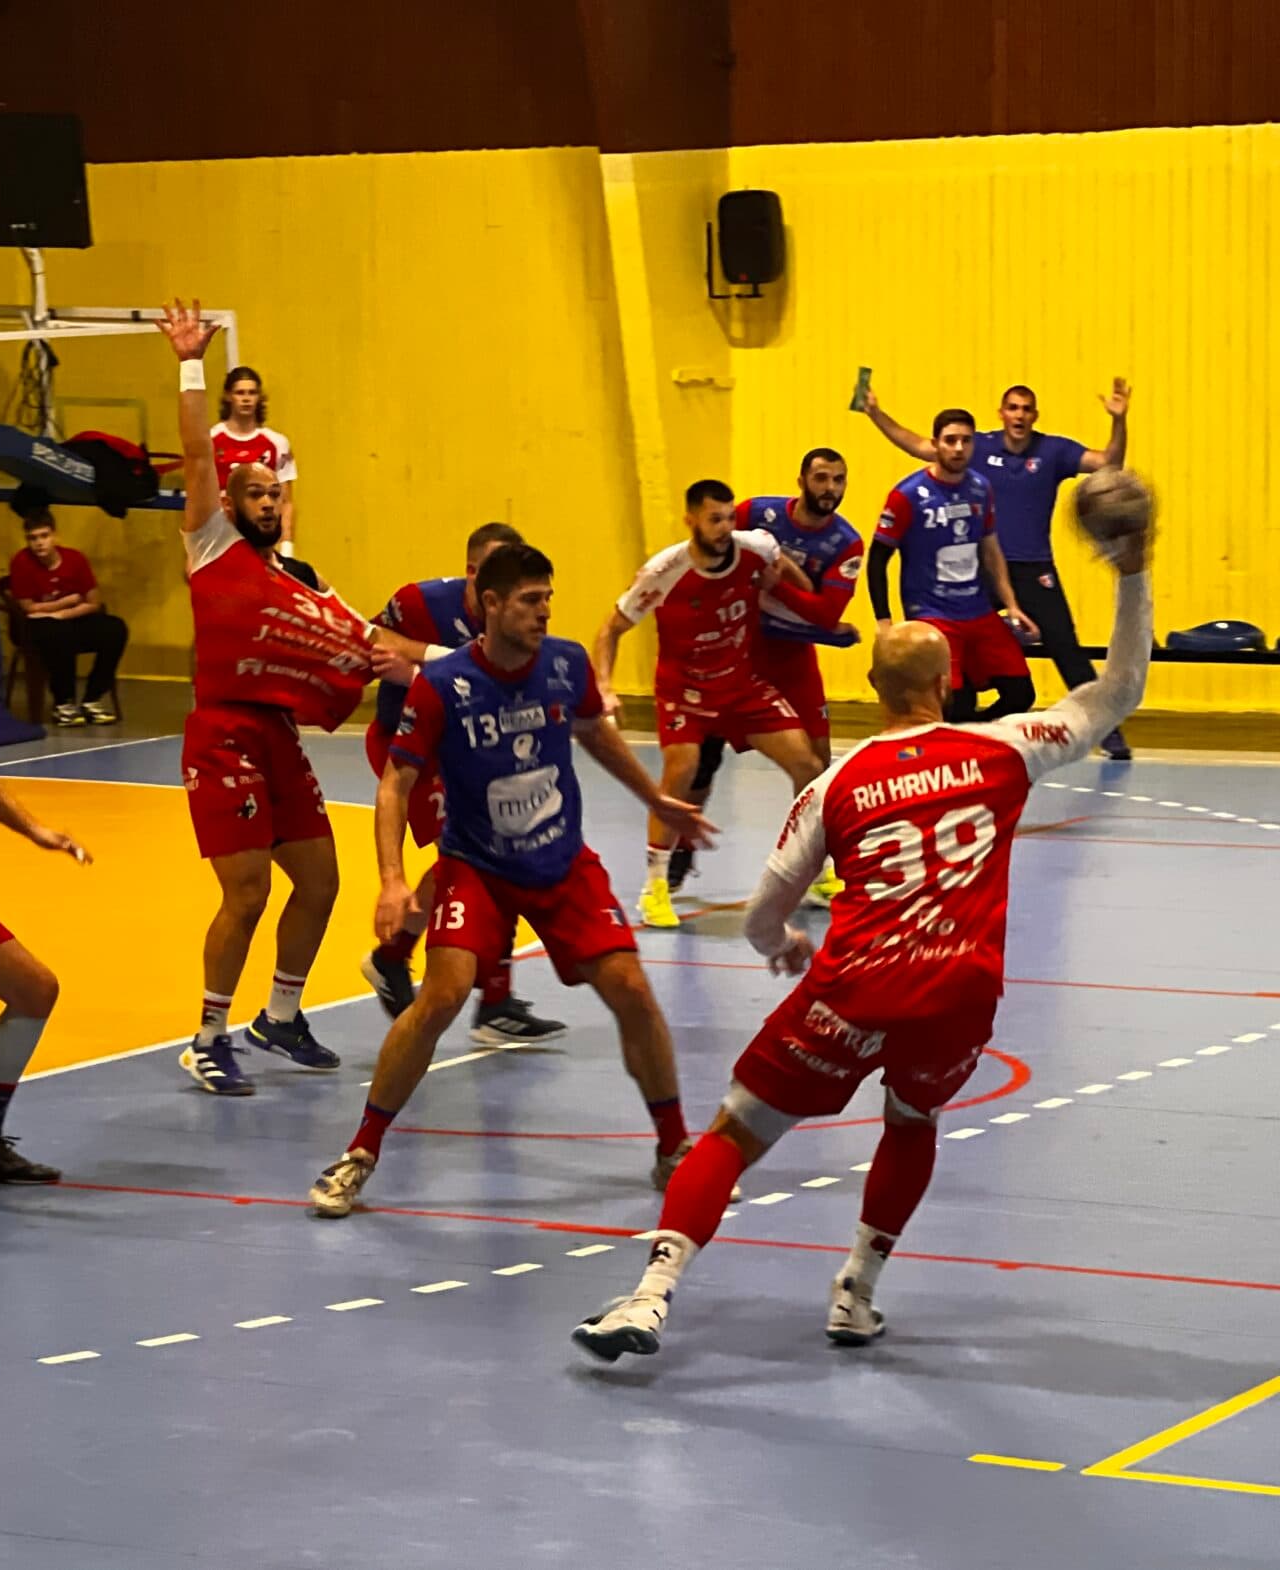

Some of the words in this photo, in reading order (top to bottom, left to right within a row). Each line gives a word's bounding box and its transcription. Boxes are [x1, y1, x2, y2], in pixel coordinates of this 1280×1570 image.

[923, 506, 948, 528] 24
[461, 713, 499, 748] 13
[857, 803, 997, 901] 39
[433, 900, 465, 931] 13
